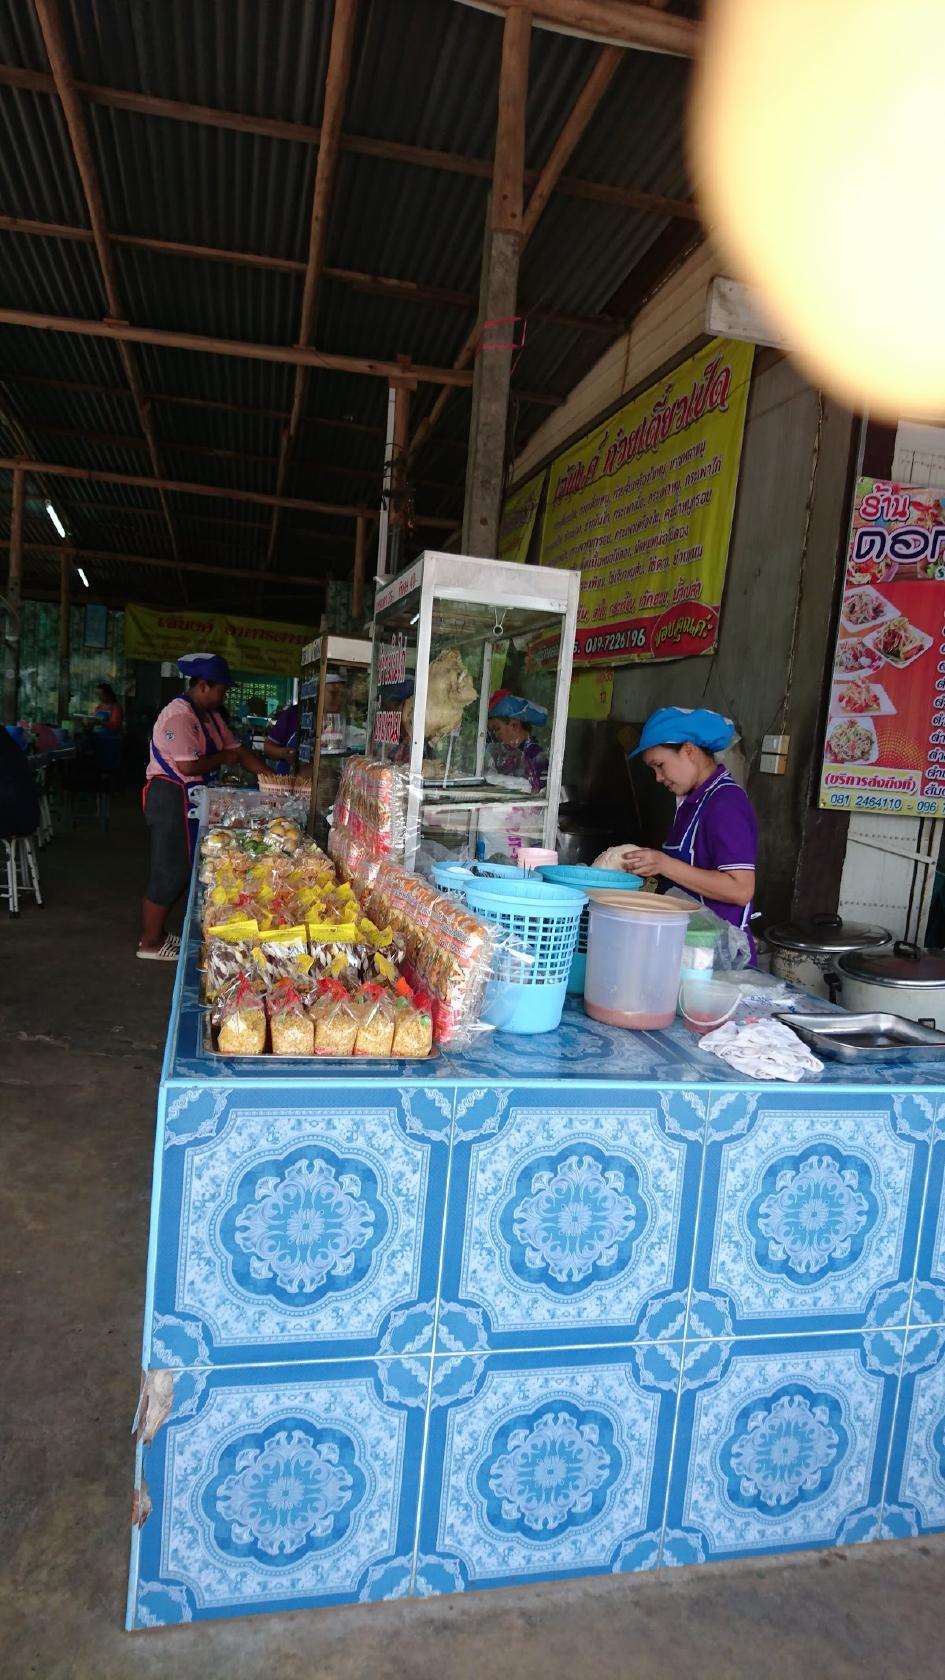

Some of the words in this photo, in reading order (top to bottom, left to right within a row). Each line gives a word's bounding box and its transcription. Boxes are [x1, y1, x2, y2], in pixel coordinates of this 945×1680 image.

[860, 483, 910, 521] ร้าน
[830, 794, 850, 806] 081
[855, 796, 902, 809] 2464110
[917, 801, 937, 813] 096
